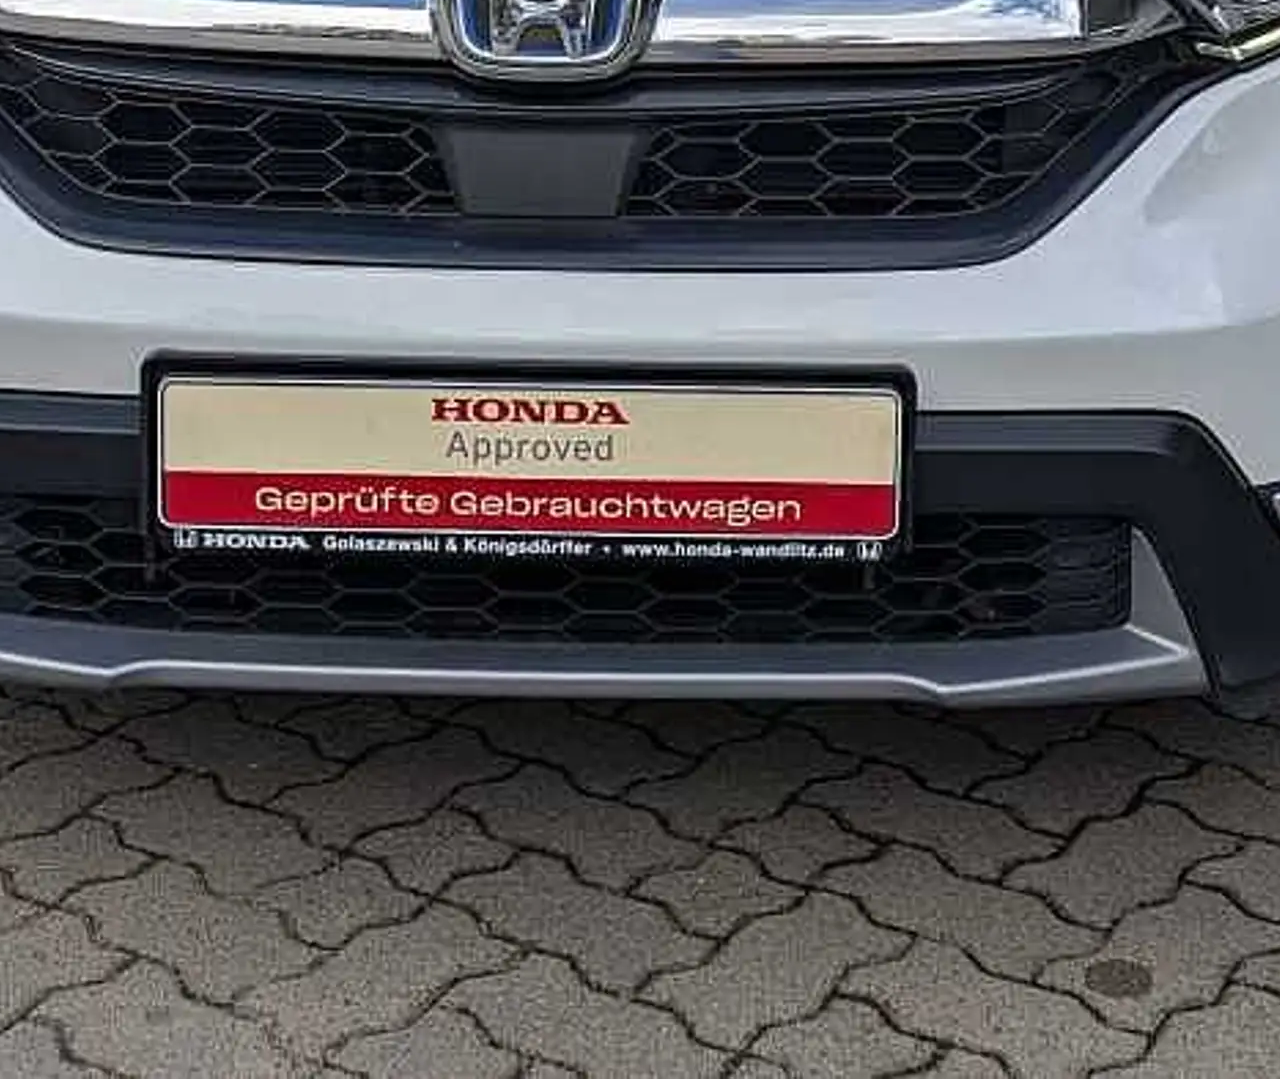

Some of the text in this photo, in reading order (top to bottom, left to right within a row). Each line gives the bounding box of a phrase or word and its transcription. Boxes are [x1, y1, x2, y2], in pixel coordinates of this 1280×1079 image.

[431, 397, 630, 425] HONDA
[446, 431, 614, 466] Approved
[255, 486, 802, 527] Geprüfte Gebrauchtwagen
[203, 534, 844, 559] HONDA Golaszewski & Königsdörffer www.honda-wandlitz.de
